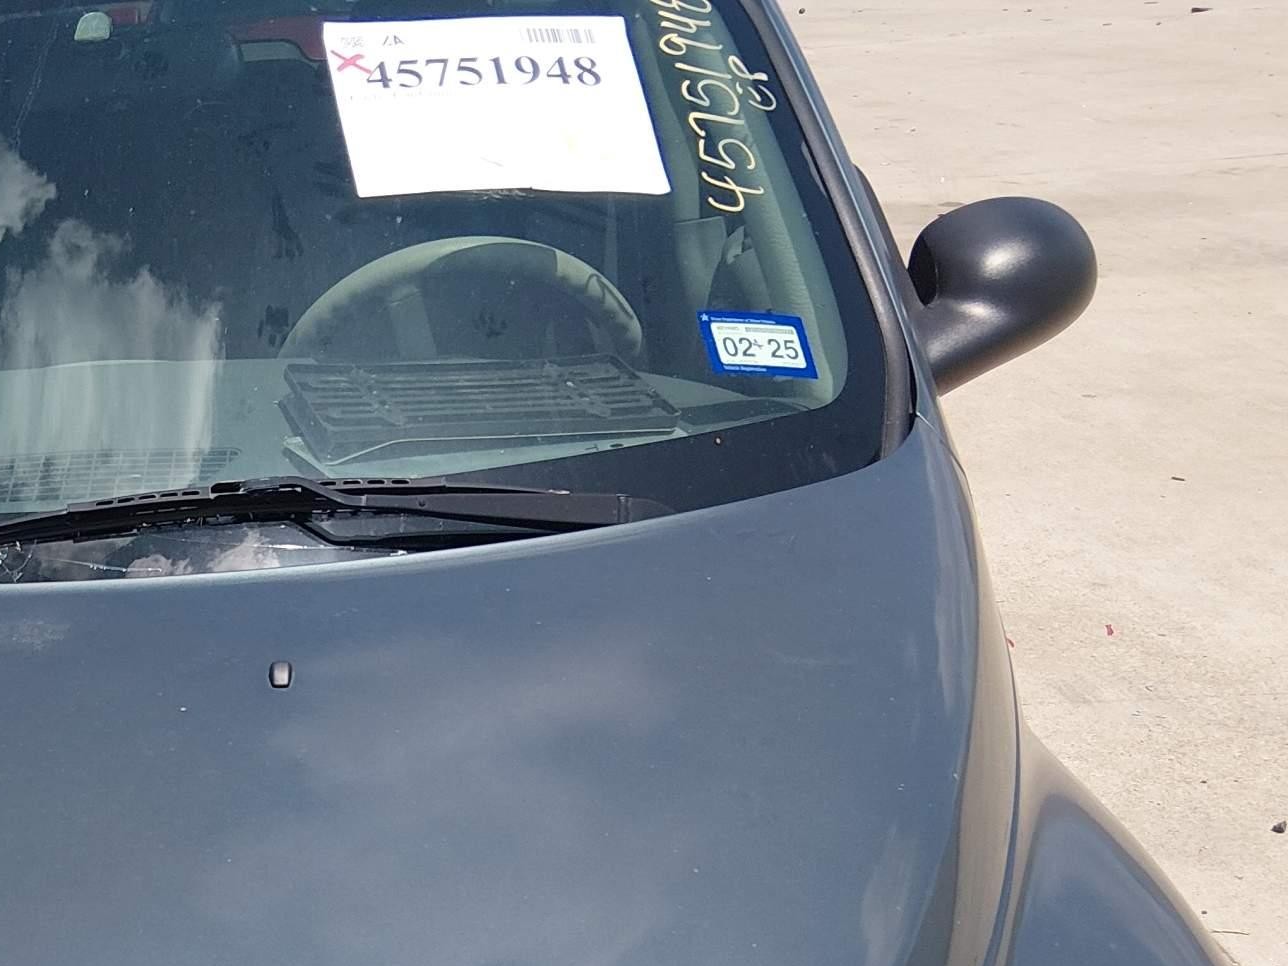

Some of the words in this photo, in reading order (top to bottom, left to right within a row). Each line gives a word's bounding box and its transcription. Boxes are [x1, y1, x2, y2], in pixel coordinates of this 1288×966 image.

[366, 55, 602, 89] 45751948
[722, 336, 756, 357] 02
[767, 338, 799, 360] 25
